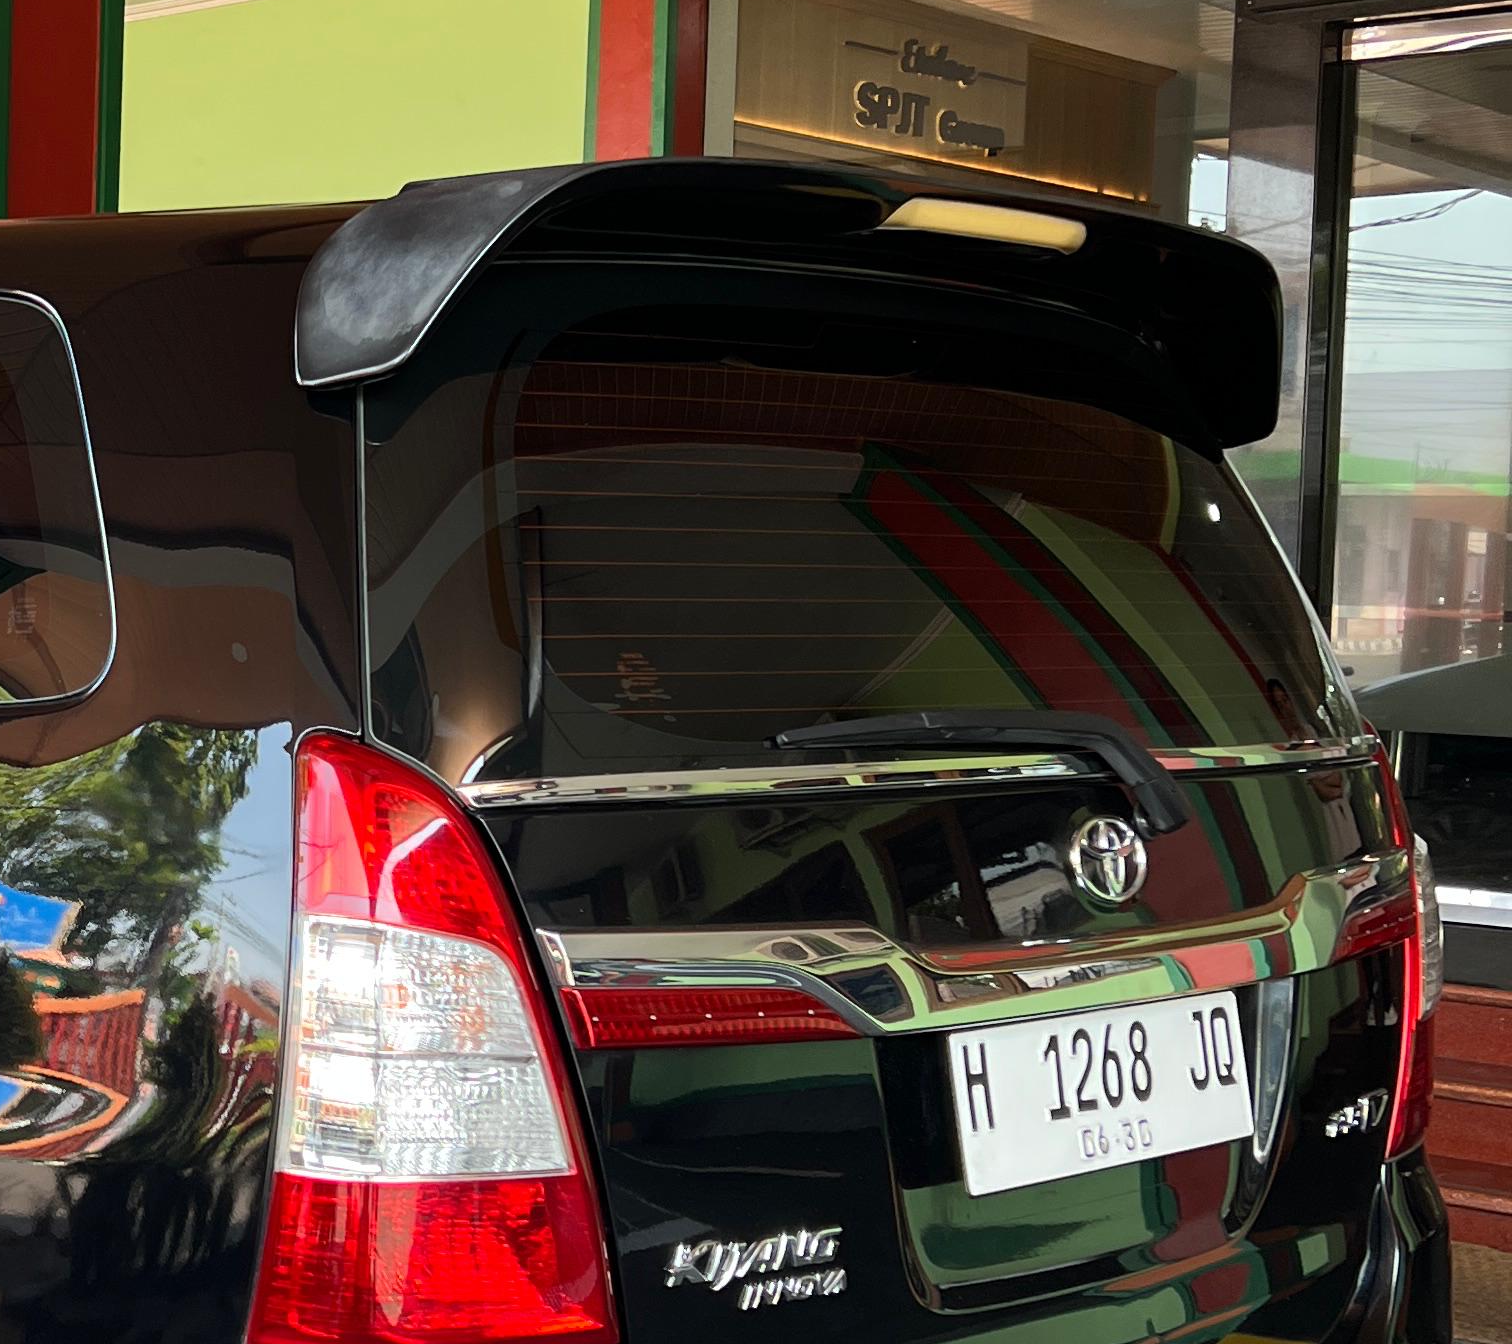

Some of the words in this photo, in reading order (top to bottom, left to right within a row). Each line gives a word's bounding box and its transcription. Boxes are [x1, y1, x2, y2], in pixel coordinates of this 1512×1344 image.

[854, 81, 931, 137] SPJT
[963, 1042, 995, 1133] H
[1044, 1021, 1153, 1120] 1268
[1190, 1006, 1237, 1091] JQ
